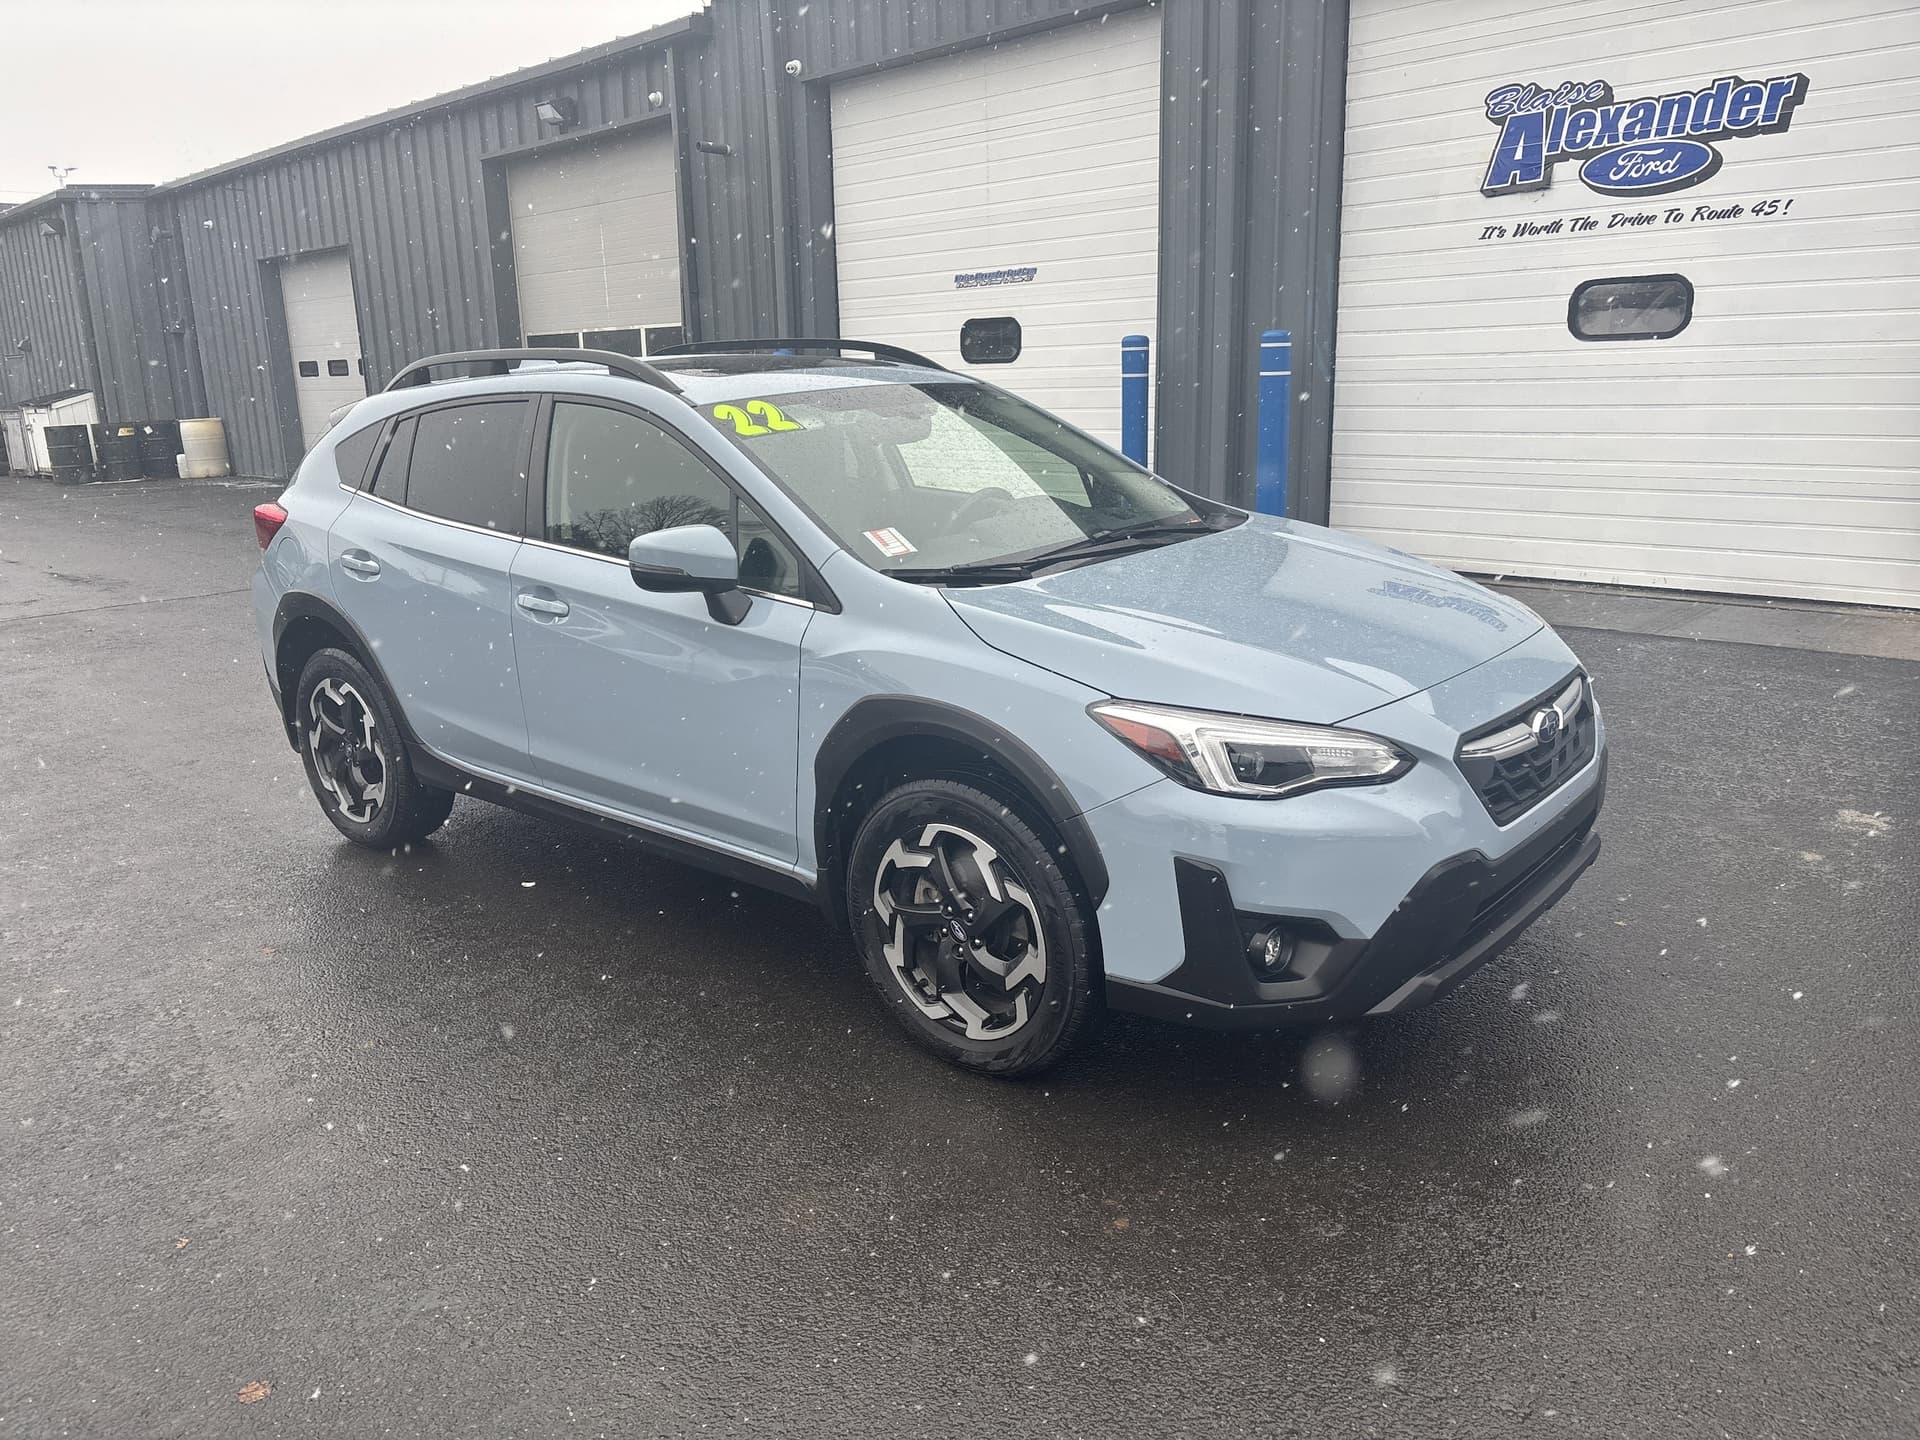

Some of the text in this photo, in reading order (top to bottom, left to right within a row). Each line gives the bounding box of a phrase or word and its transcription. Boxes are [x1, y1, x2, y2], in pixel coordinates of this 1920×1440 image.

[1486, 82, 1606, 119] Blaise
[1482, 76, 1799, 190] Alexander
[1608, 148, 1682, 181] Ford
[1478, 225, 1507, 241] It's
[1512, 218, 1564, 238] Worth
[1569, 215, 1599, 233] The
[1607, 212, 1658, 229] Drive
[1663, 207, 1685, 224] To
[1690, 203, 1745, 222] Route
[713, 400, 806, 438] 22
